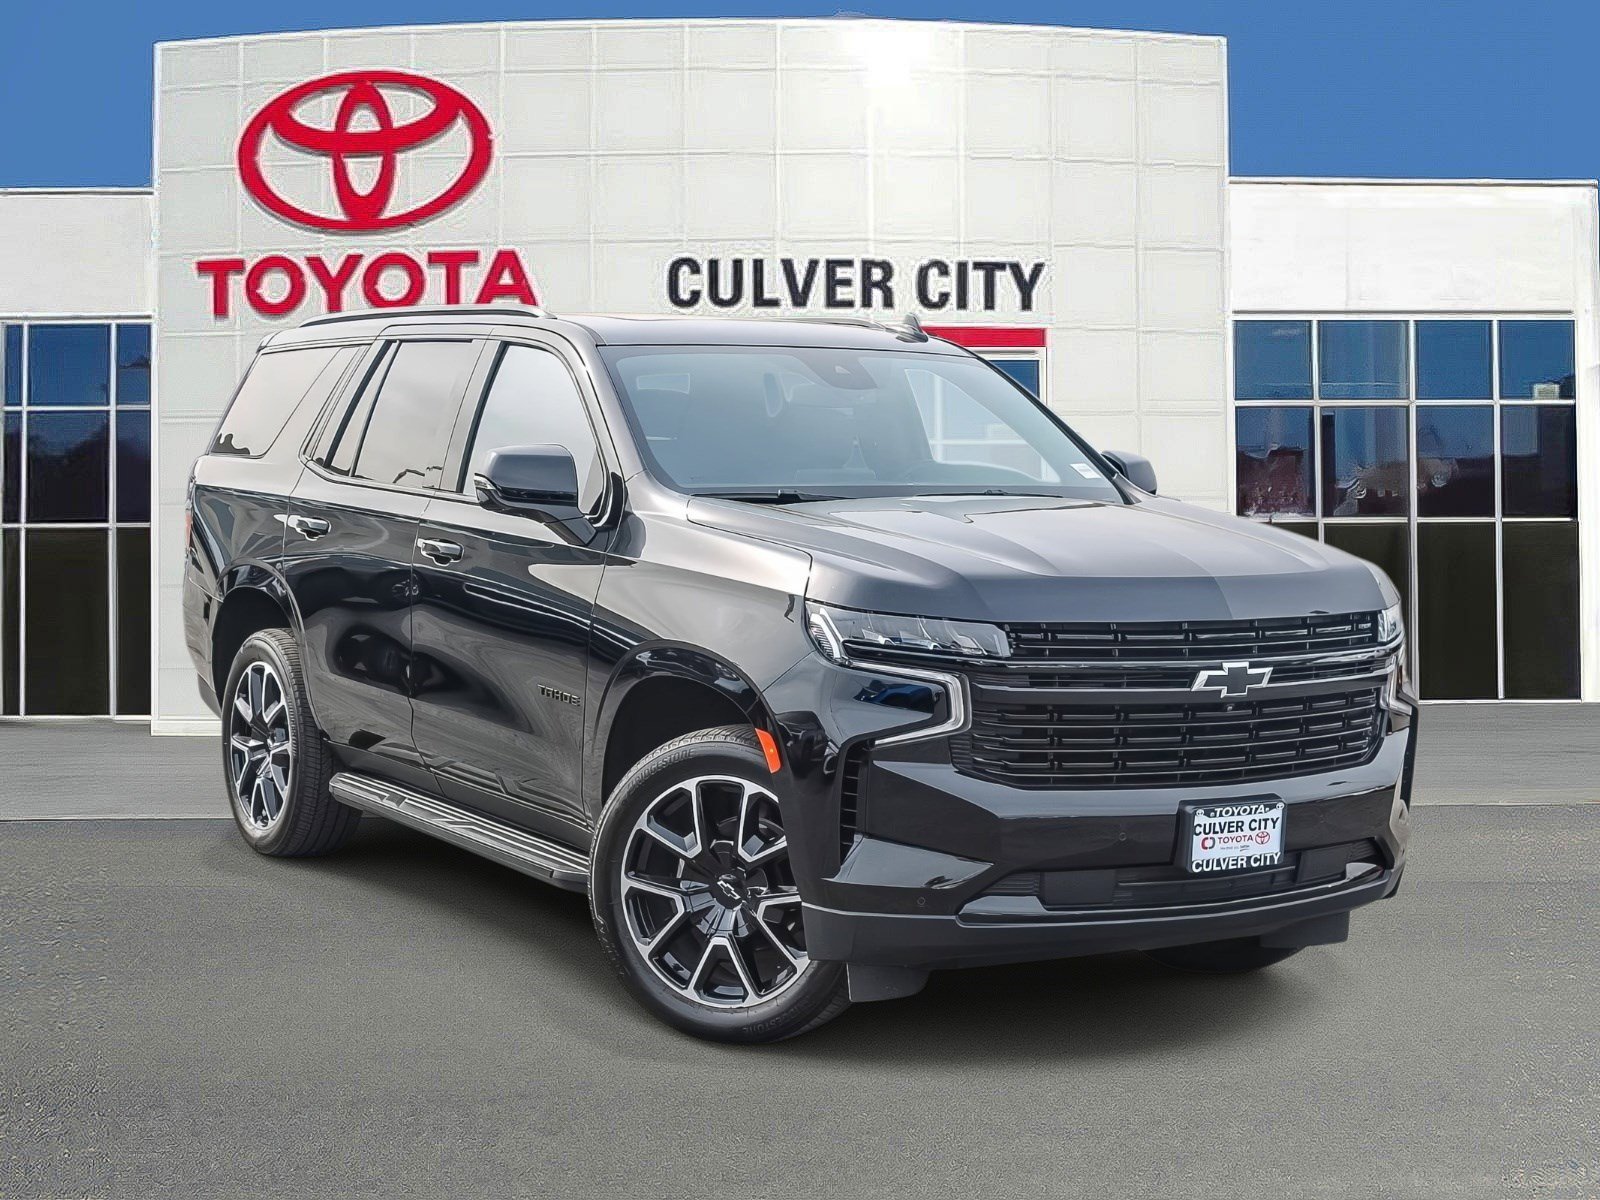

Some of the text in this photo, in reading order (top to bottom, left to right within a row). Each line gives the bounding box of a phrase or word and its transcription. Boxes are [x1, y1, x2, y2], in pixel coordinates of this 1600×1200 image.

[195, 249, 538, 318] TOYOTA
[668, 258, 1045, 312] CULVER CITY
[537, 684, 581, 707] TAHOE
[1214, 804, 1265, 818] TOYOTA
[1194, 816, 1280, 836] CULVER CITY
[1217, 834, 1254, 845] TOYOTA
[1192, 852, 1281, 873] CULVER CITY
